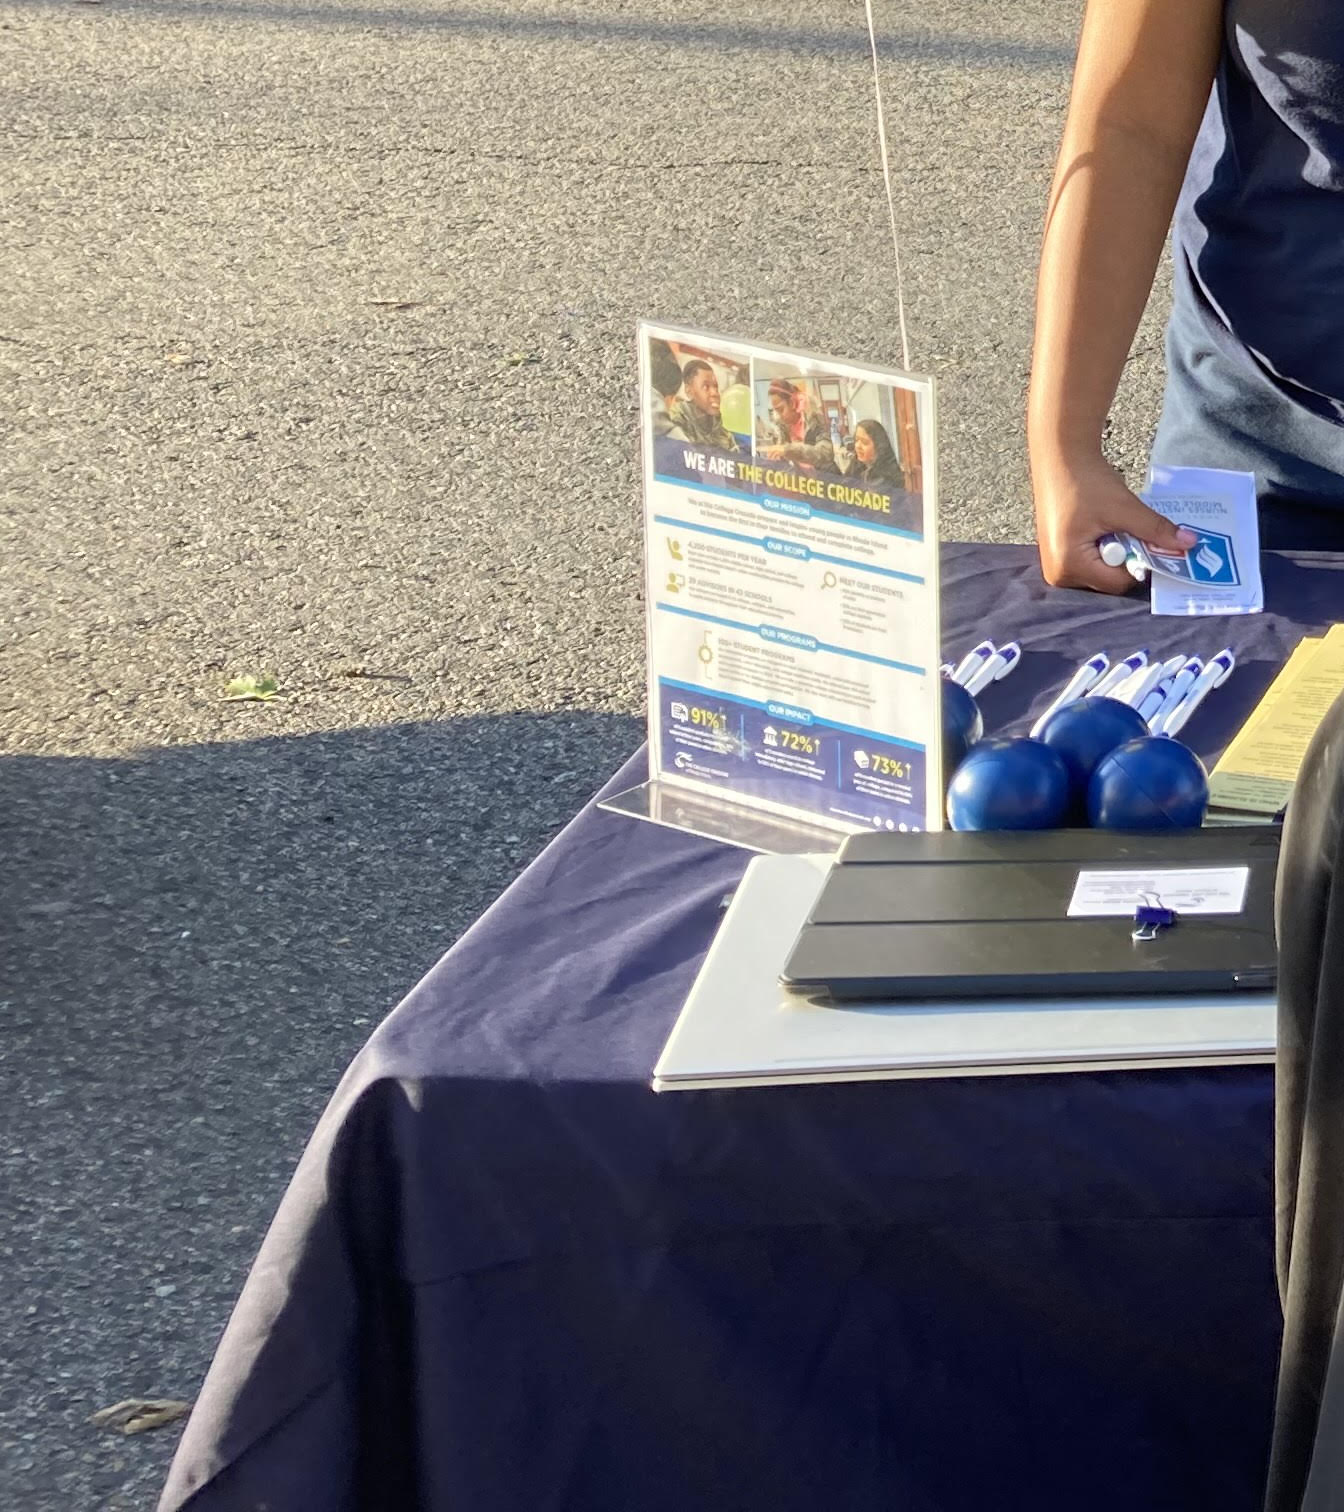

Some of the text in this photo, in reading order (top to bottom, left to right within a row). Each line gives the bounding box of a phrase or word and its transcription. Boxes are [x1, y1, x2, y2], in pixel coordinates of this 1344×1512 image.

[683, 450, 891, 513] WE ARE THE COLLEGE CRUSADE
[763, 499, 810, 516] OUR MISSION
[767, 540, 808, 558] OUR SCOPE
[777, 631, 816, 648] PROGRAMS
[691, 707, 720, 728] 91%
[768, 704, 811, 722] OUR IMPACT
[781, 730, 813, 753] 72%
[871, 754, 904, 778] 73%
